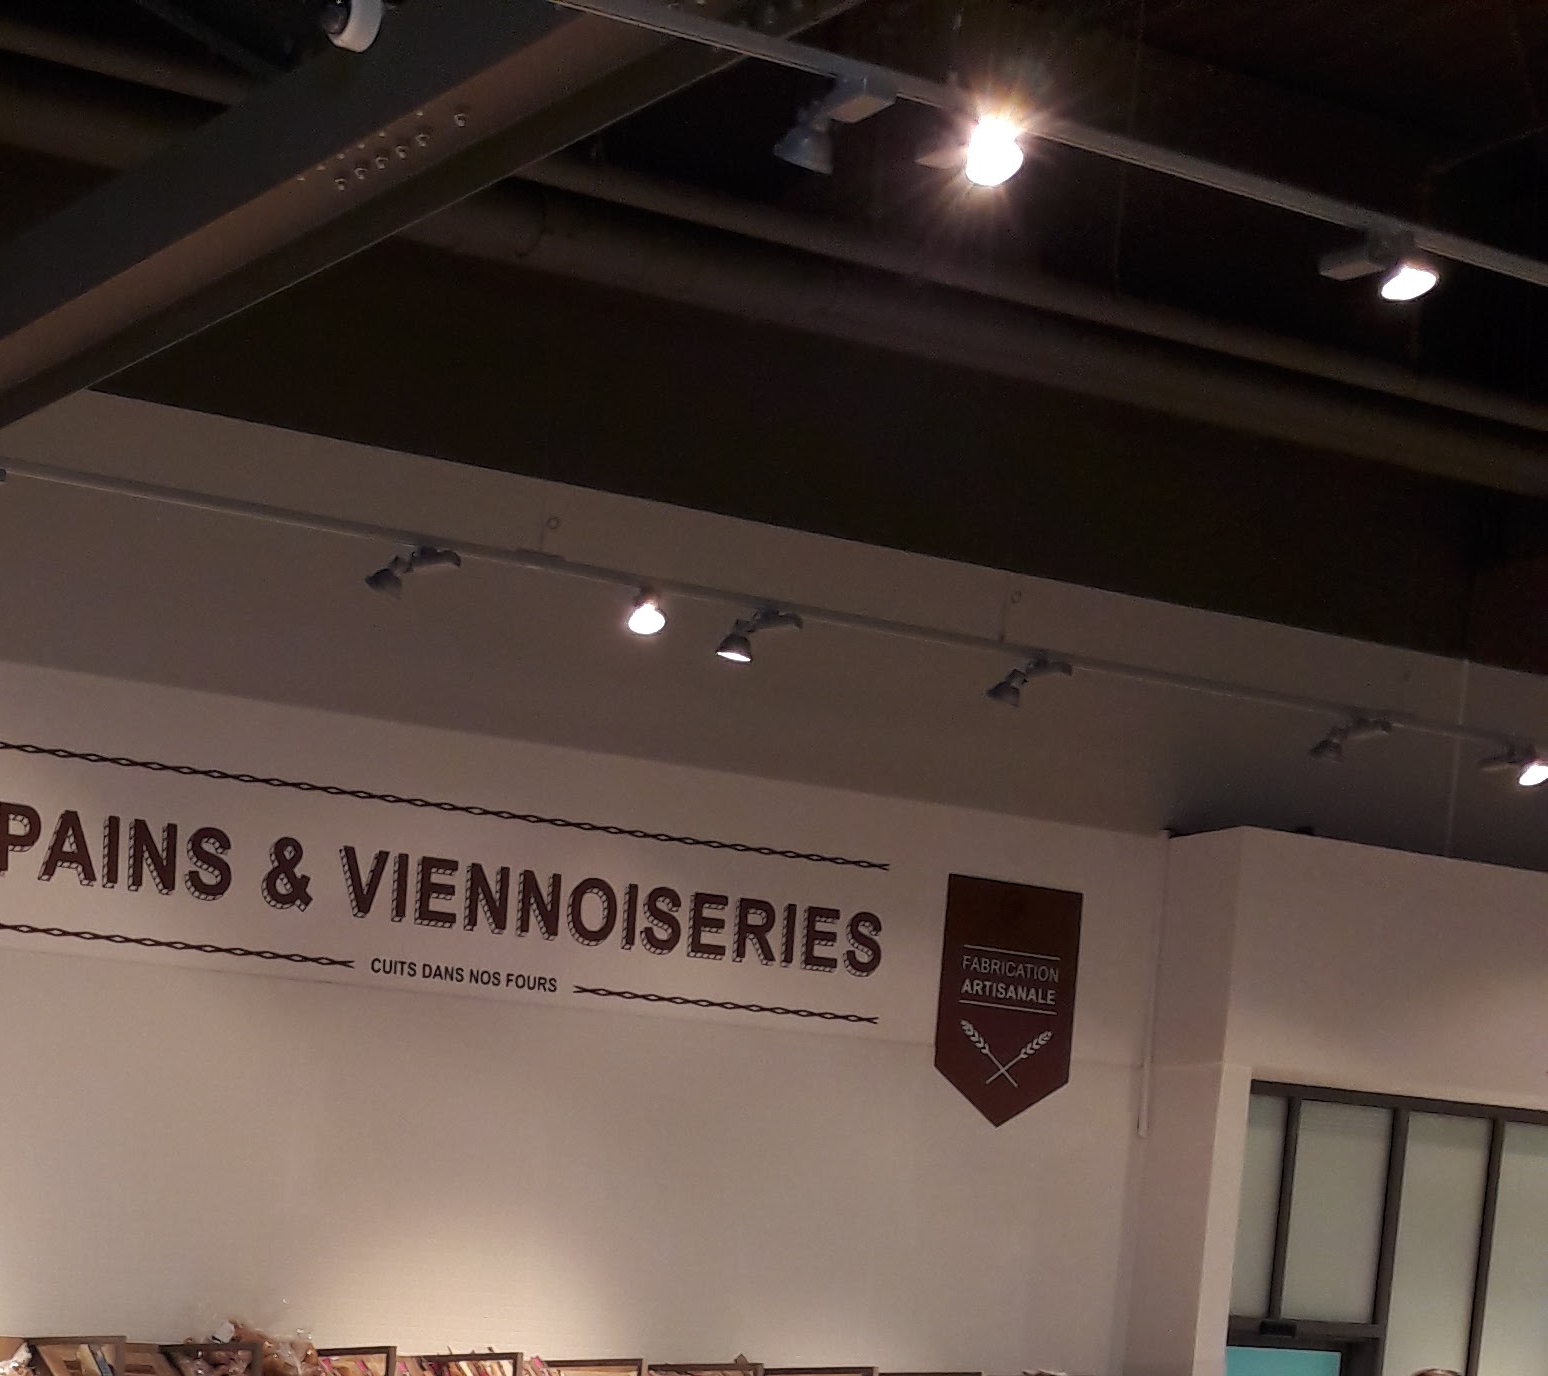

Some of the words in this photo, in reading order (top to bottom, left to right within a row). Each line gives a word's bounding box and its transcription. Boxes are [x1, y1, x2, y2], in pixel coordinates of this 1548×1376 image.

[261, 837, 313, 912] &
[339, 844, 883, 978] VIENNOISERIES
[371, 957, 417, 978] CUITS
[422, 963, 465, 983] DANS
[469, 968, 502, 987] NOS
[505, 973, 558, 993] FOURS
[962, 955, 1060, 984] FABRICATION
[960, 978, 1057, 1006] ARTISANALE
